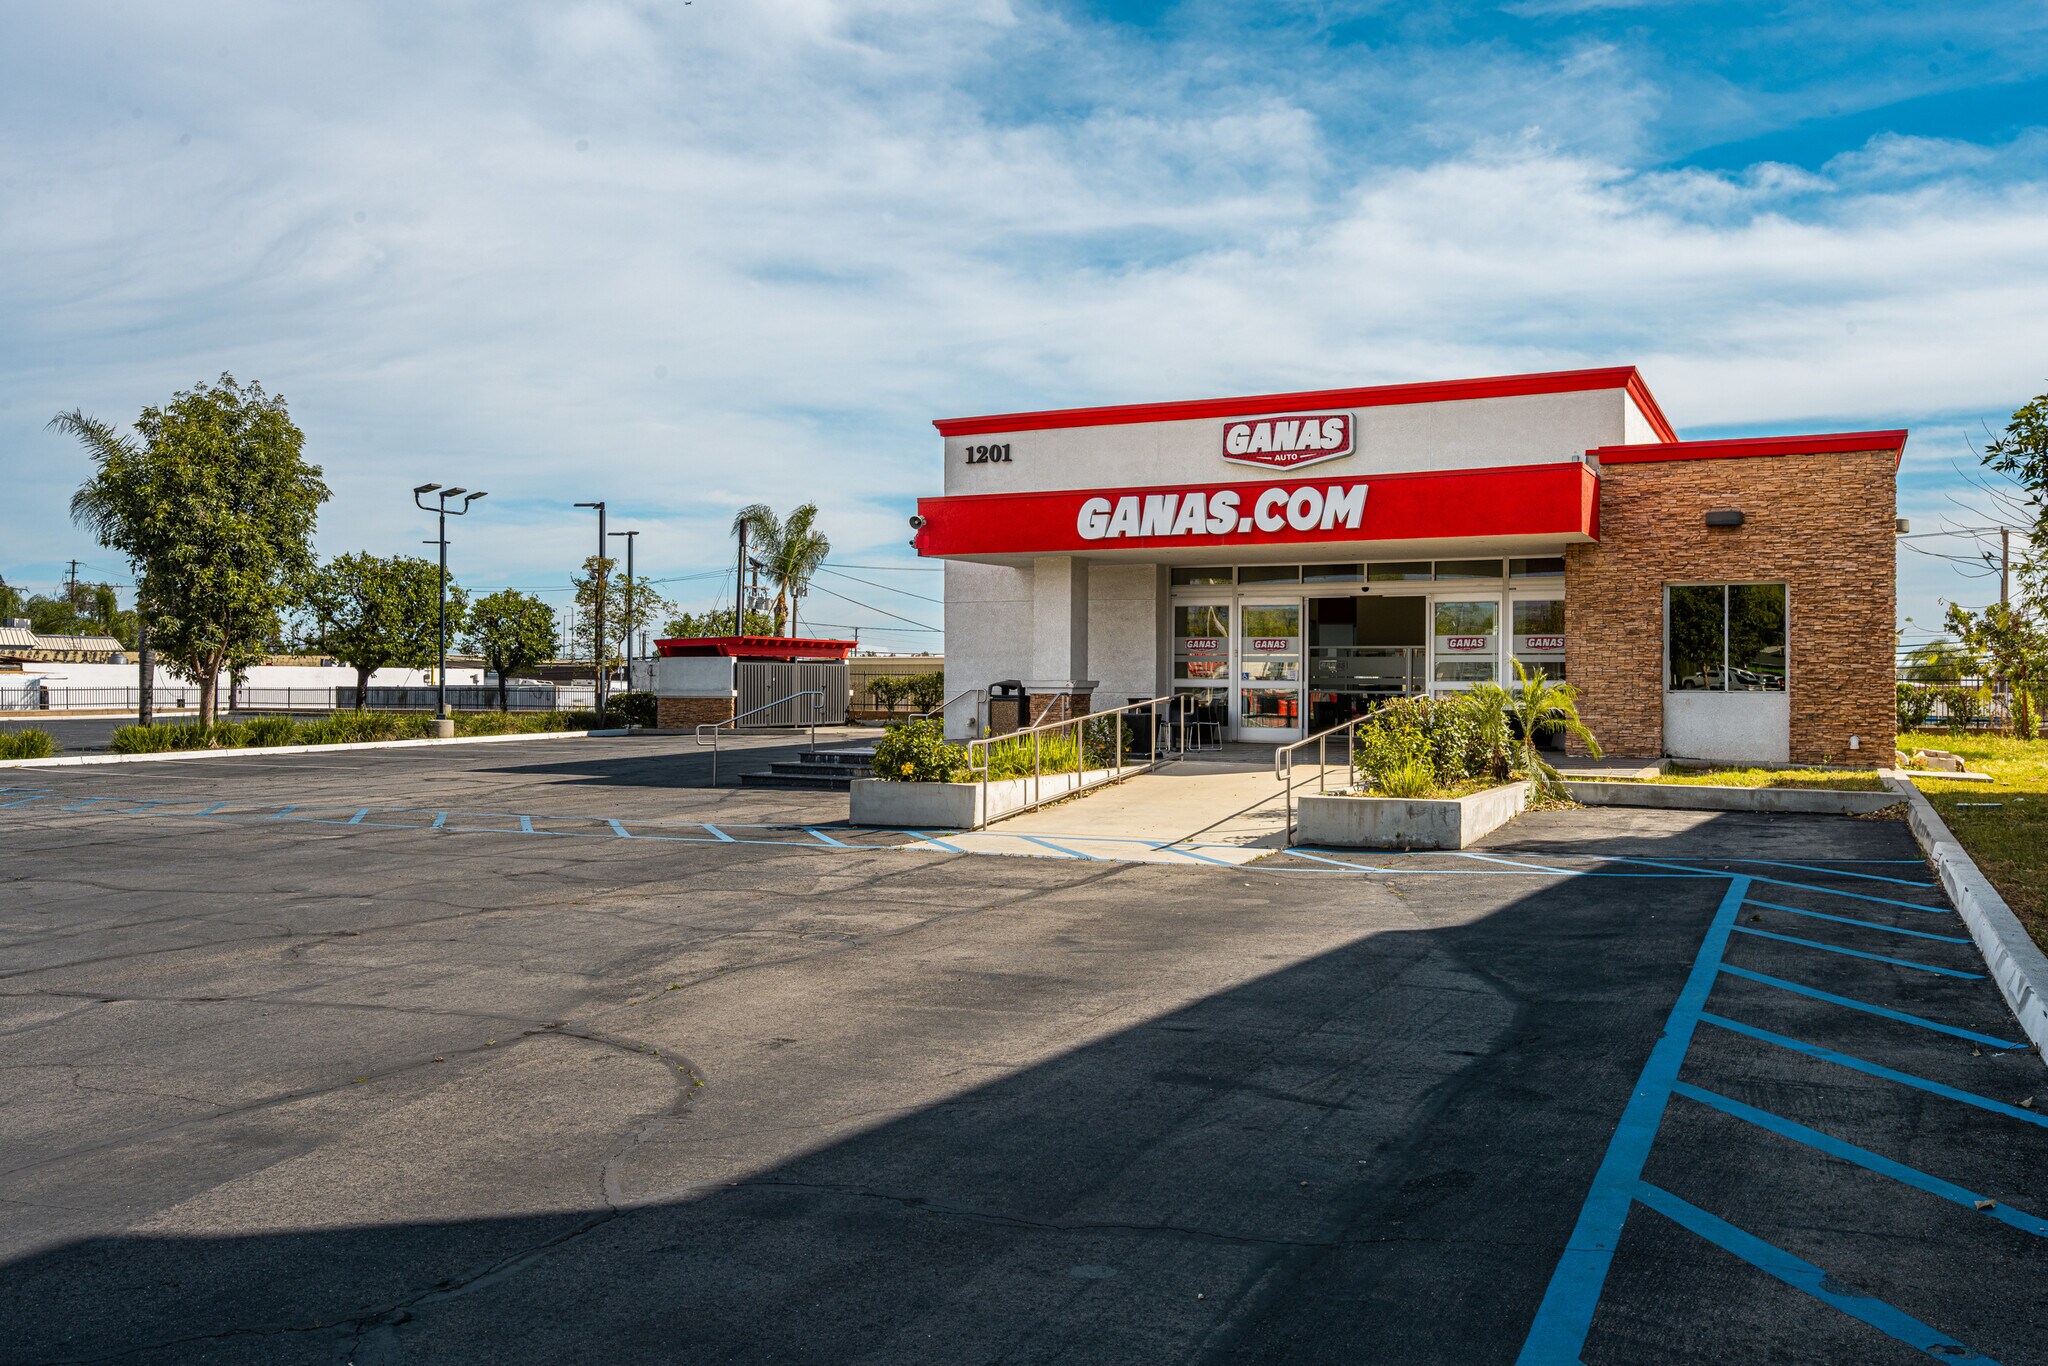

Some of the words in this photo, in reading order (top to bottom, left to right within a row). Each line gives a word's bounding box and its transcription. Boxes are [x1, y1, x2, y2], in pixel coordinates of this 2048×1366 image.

[1226, 417, 1345, 455] GANAS
[966, 443, 1013, 465] 1201
[1274, 453, 1298, 461] AUTO
[1077, 484, 1369, 540] GANAS.COM
[1186, 640, 1217, 649] GANAS
[1254, 640, 1286, 649] GANAS
[1449, 638, 1484, 648] GANAS
[1527, 638, 1564, 647] GANAS
